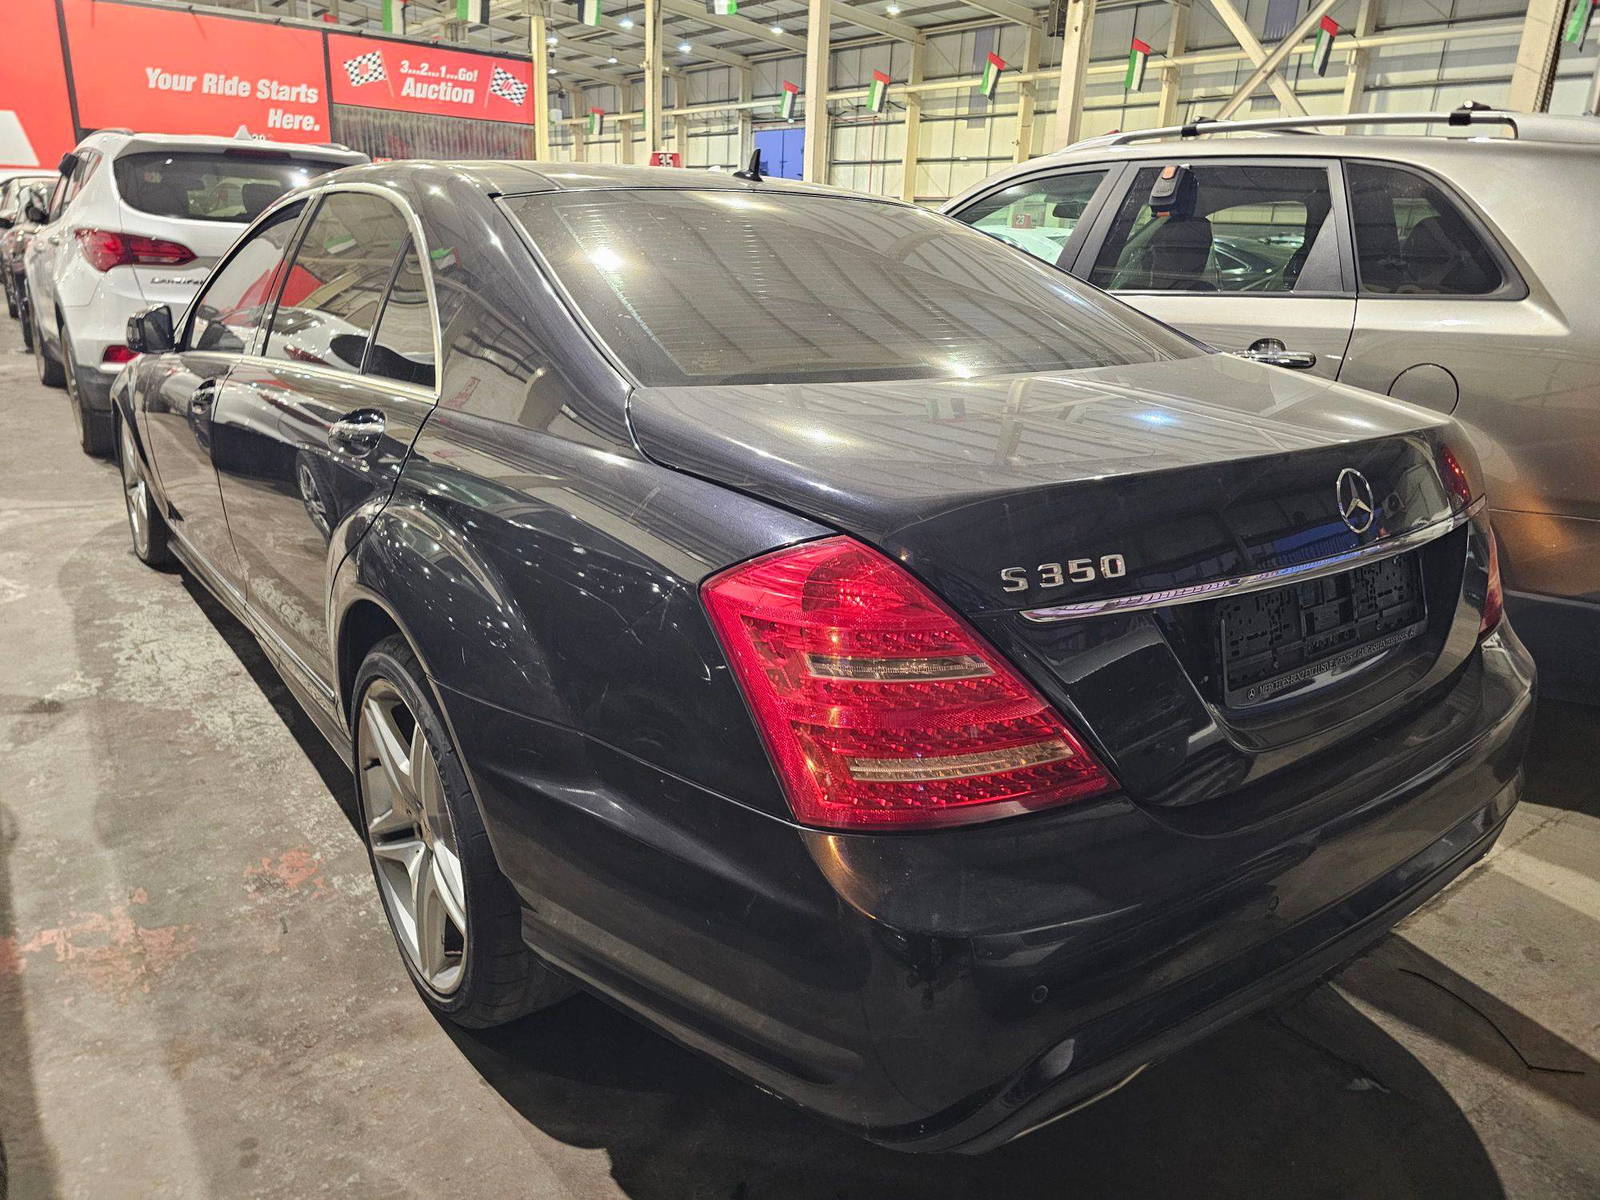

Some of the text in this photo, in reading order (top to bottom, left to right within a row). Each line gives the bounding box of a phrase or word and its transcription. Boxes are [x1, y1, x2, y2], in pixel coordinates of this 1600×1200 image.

[145, 67, 319, 104] Your Ride Starts
[401, 77, 475, 104] Auction
[267, 108, 320, 131] Here.
[658, 153, 673, 167] 35
[1001, 554, 1126, 592] S 350
